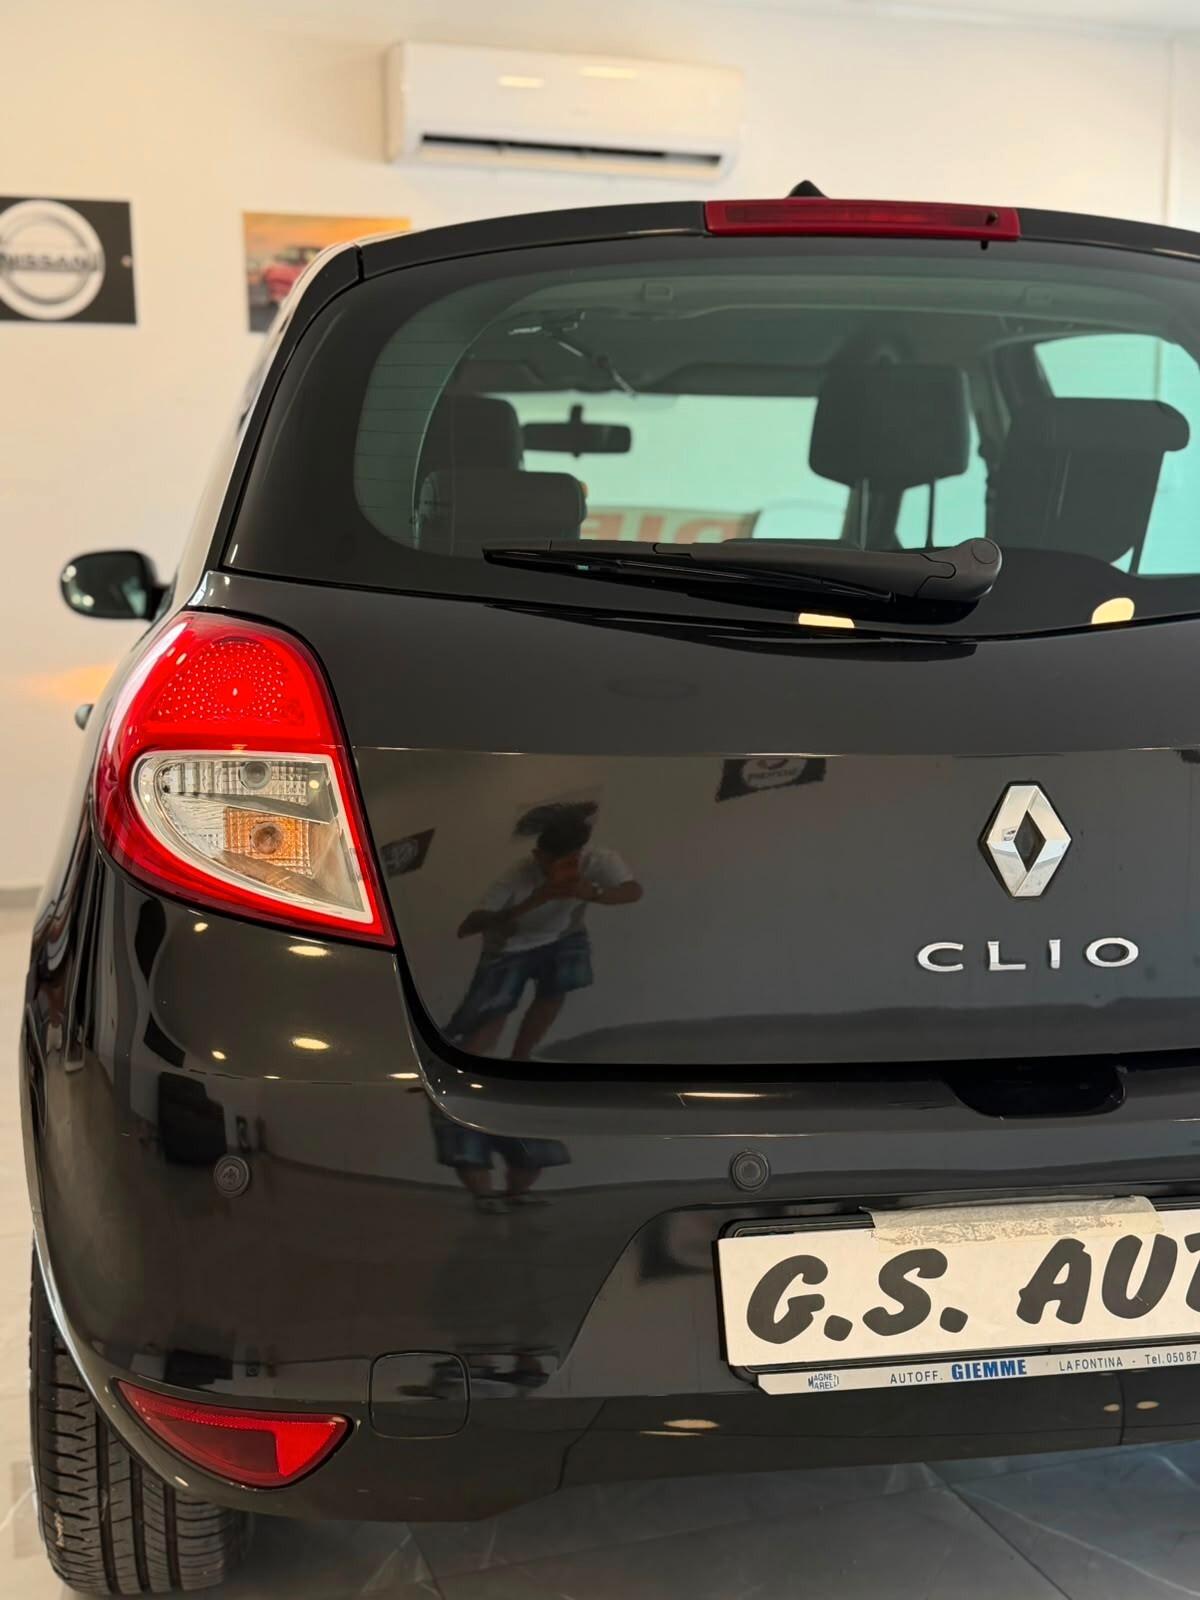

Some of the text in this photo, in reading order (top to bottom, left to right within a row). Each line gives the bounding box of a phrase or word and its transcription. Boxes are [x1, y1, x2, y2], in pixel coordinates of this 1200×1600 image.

[917, 937, 1139, 972] CLIO
[746, 1248, 969, 1344] G.S.
[890, 1370, 944, 1384] AUTOFF.
[951, 1359, 1027, 1380] GIEMME
